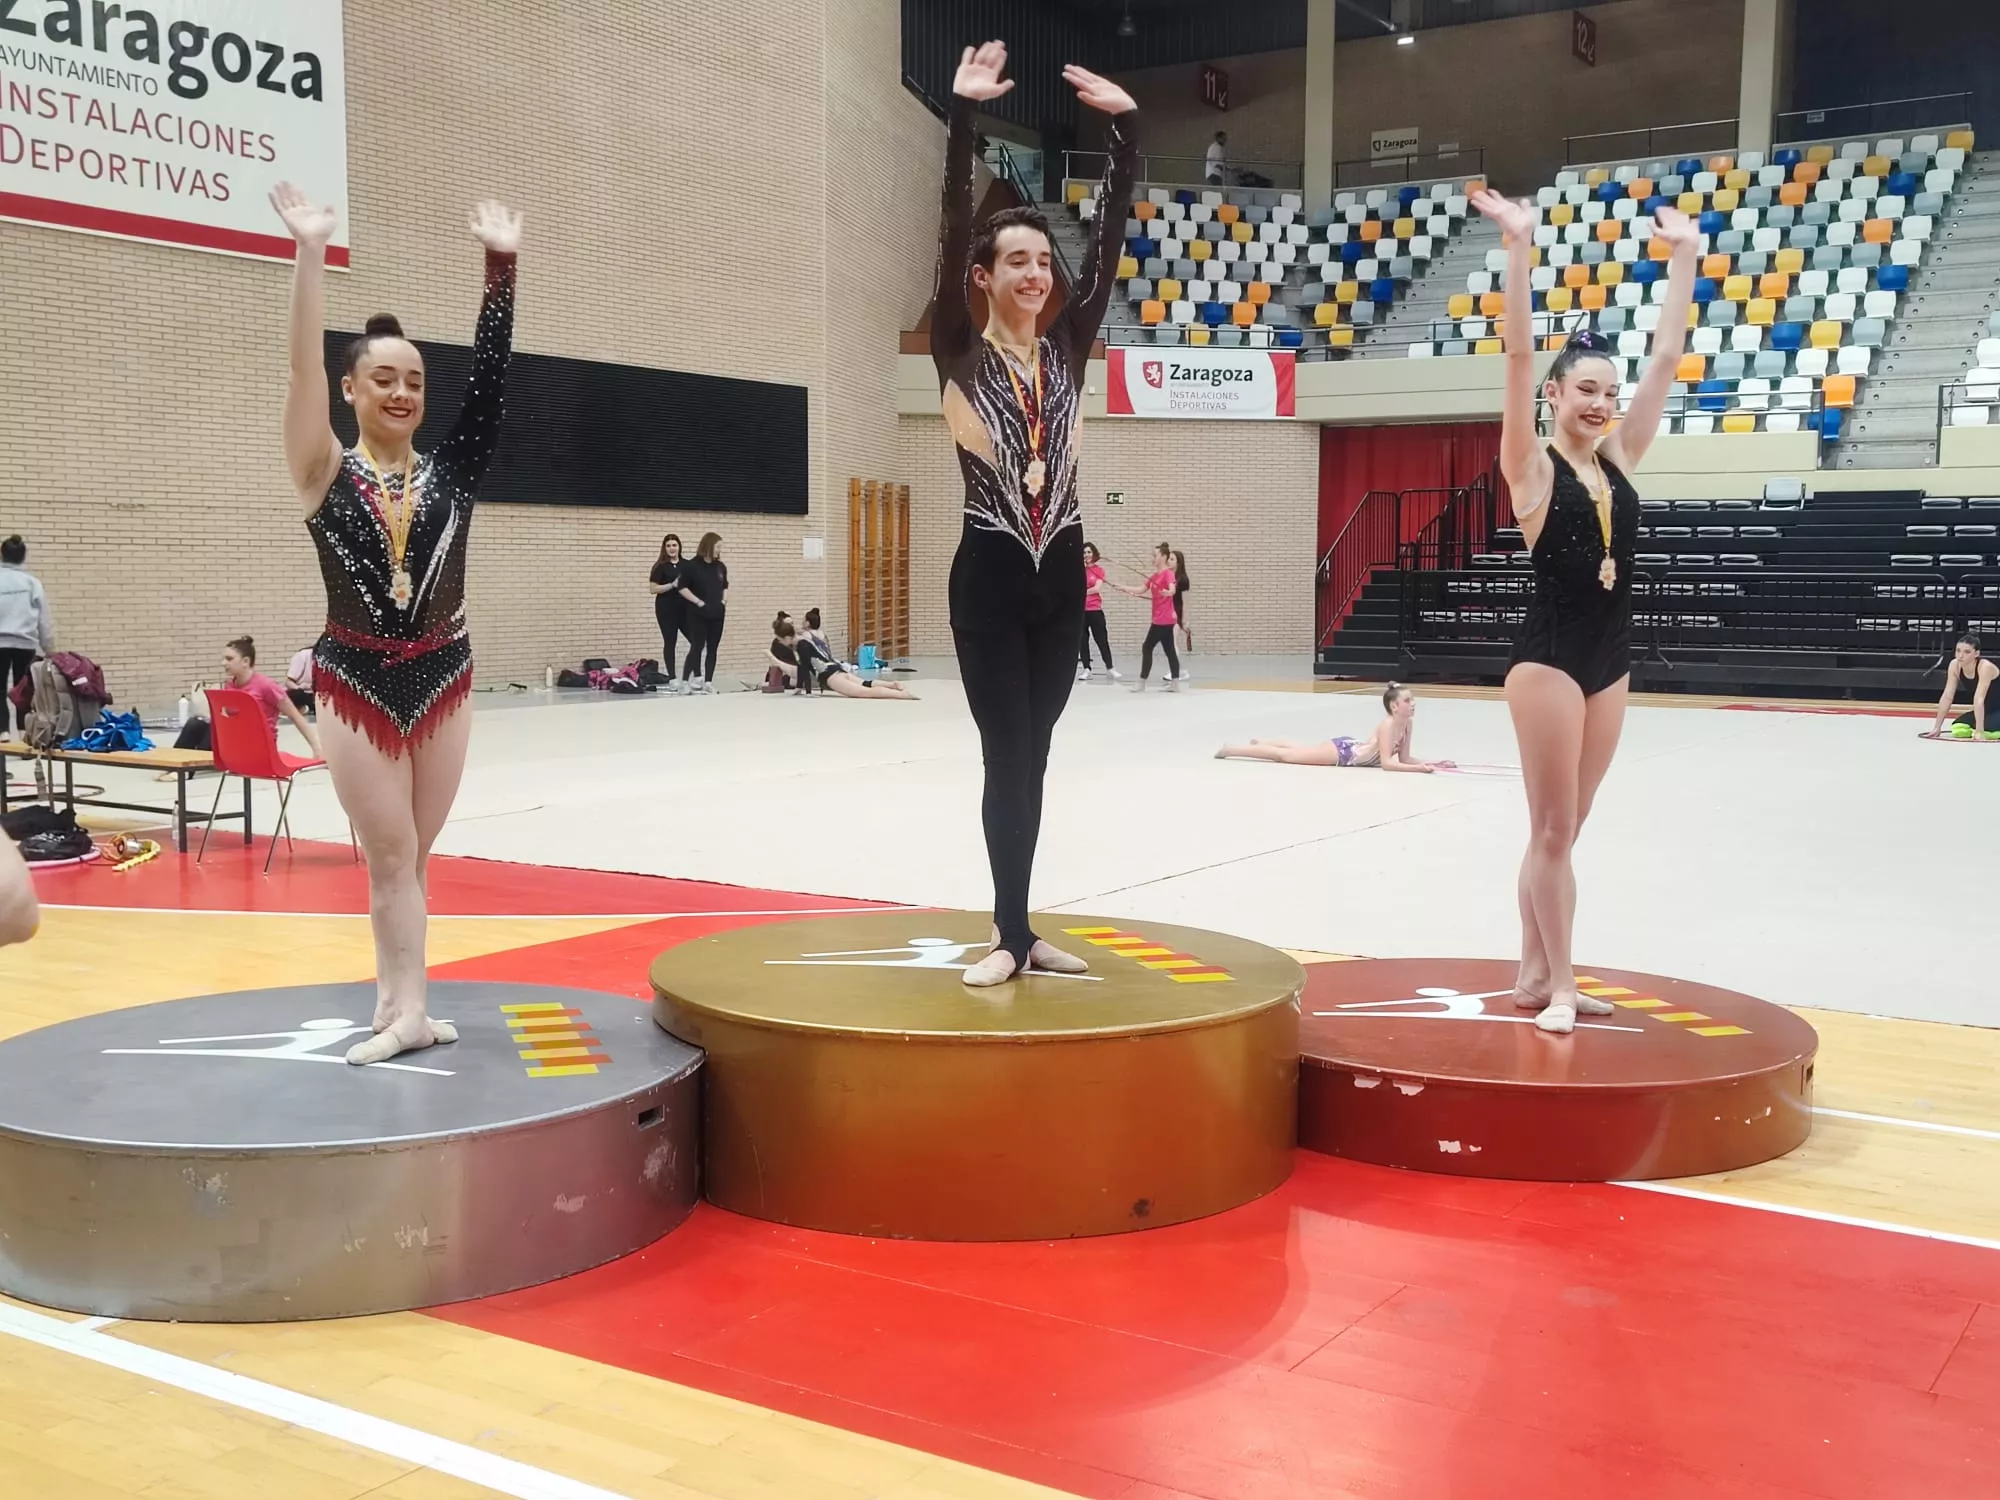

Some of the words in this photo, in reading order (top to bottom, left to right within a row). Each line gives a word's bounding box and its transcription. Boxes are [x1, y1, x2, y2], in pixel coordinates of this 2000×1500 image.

[0, 44, 158, 96] AYUNTAMIENTO
[1204, 71, 1216, 101] 11
[0, 70, 276, 162] INSTALACIONES
[1383, 139, 1418, 149] Zaragoza
[0, 123, 231, 202] DEPORTIVAS
[1169, 364, 1253, 387] Zaragoza
[1169, 389, 1240, 400] INSTALACIONES
[1170, 399, 1227, 410] DEPORTIVAS
